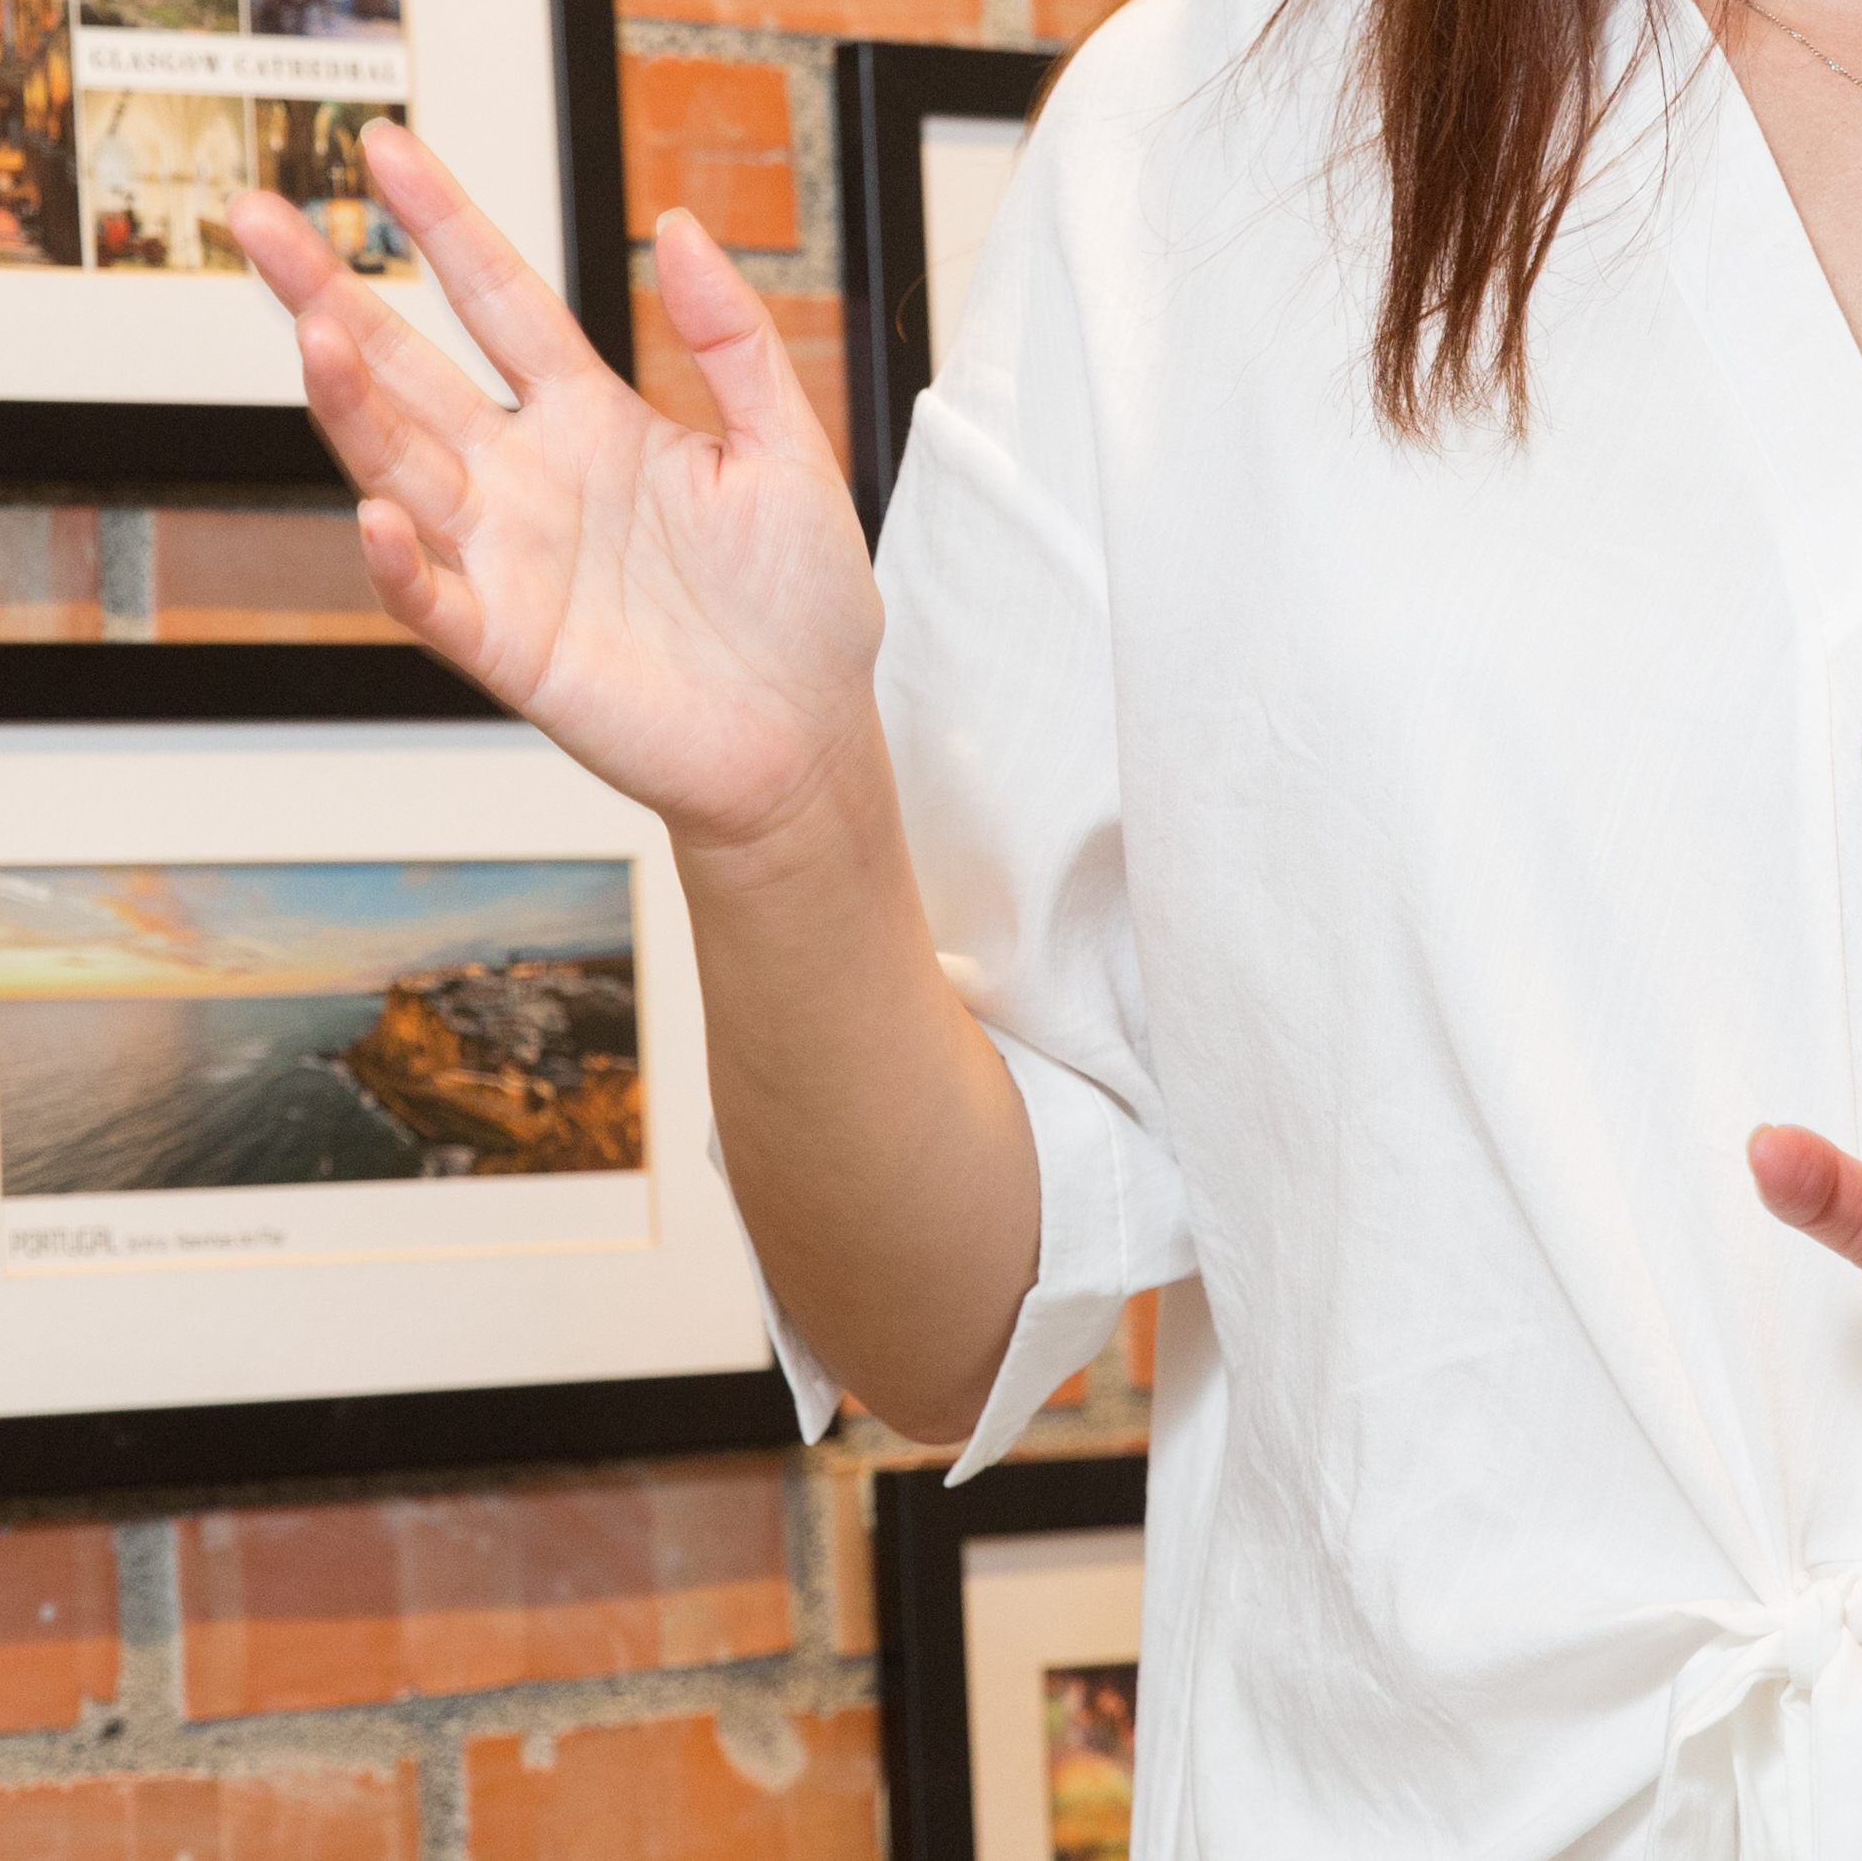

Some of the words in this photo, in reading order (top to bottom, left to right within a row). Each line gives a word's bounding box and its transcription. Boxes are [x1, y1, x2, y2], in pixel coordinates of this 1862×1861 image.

[87, 45, 221, 76] GLASGOW
[231, 52, 398, 83] CATHEDRAL
[8, 1224, 121, 1259] PORTUGAL
